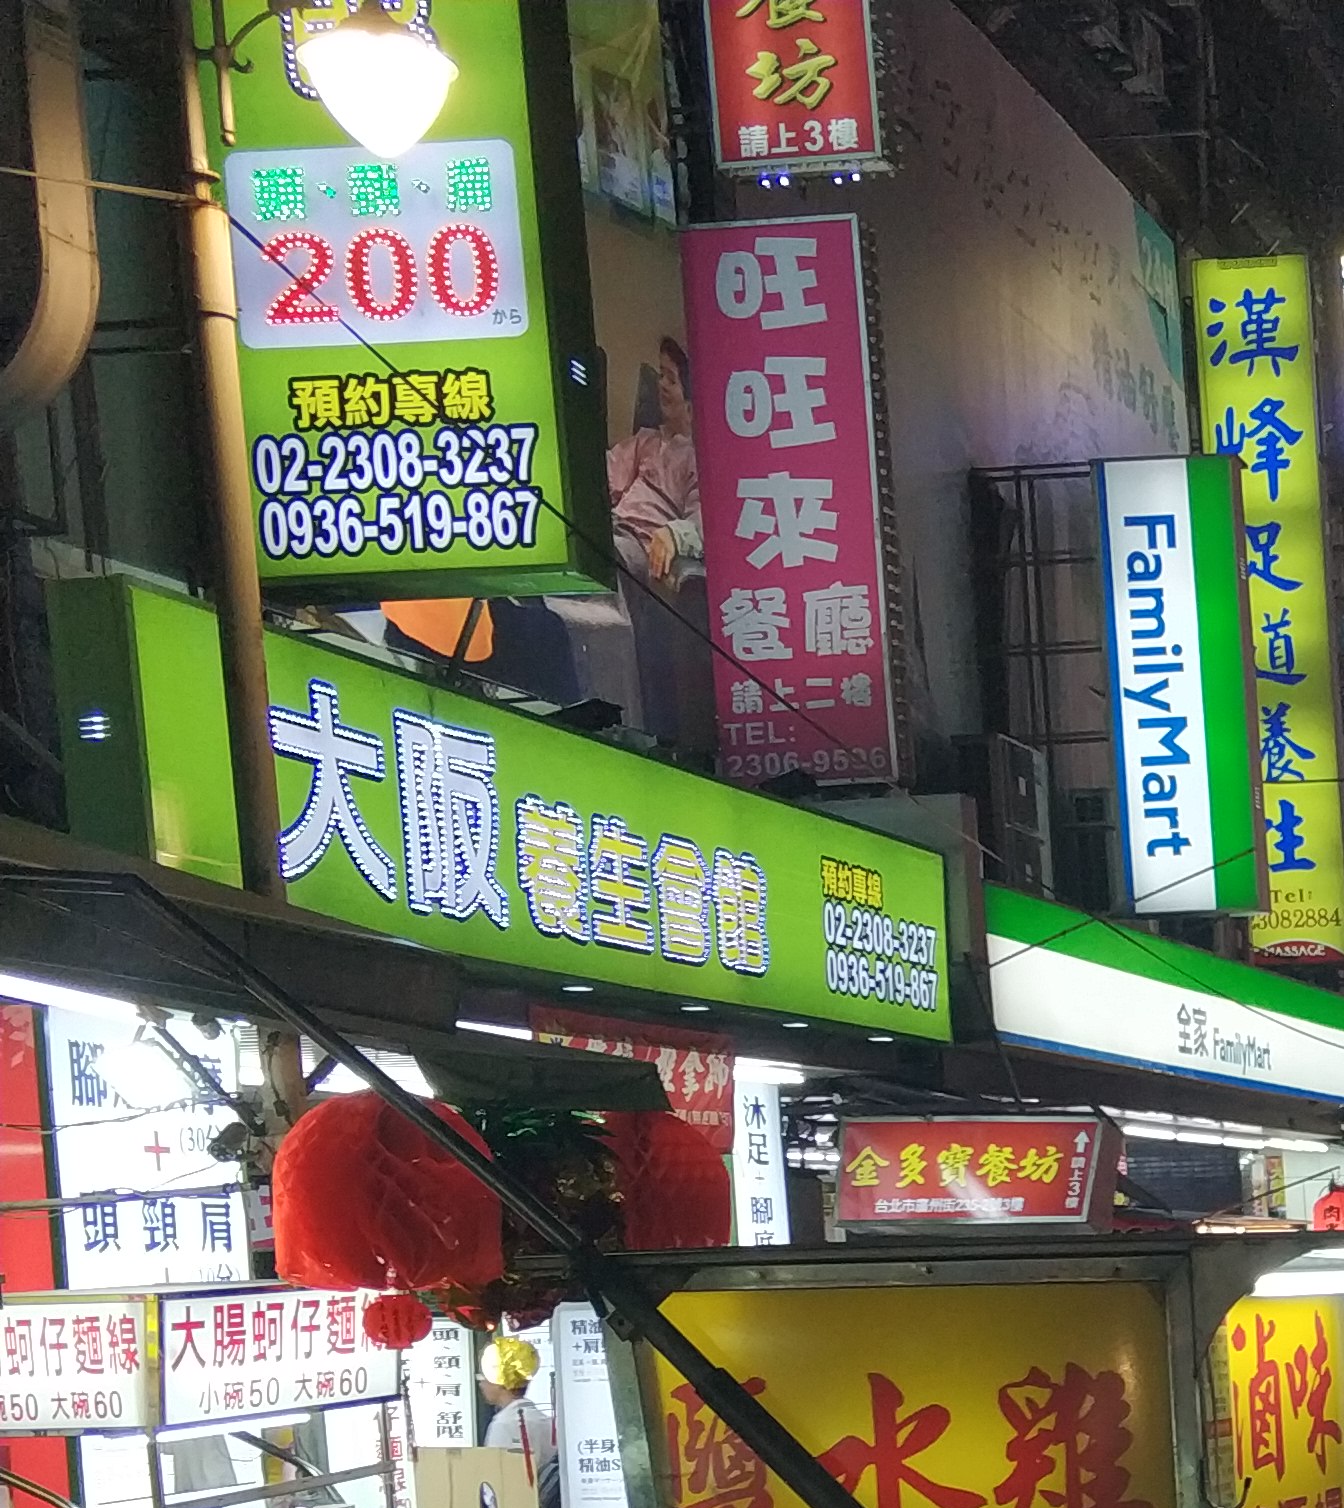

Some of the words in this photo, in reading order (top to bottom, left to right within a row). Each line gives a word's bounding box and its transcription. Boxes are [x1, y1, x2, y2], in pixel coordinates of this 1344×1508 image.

[739, 118, 858, 158] 請上3樓
[261, 222, 500, 326] 200
[290, 370, 493, 431] 預約專線
[715, 236, 840, 569] 旺旺來
[253, 425, 536, 493] 02-2308-3237
[262, 490, 541, 559] 0936-519-867
[719, 581, 874, 661] 餐廳
[730, 672, 874, 716] 請上二樓
[1122, 513, 1193, 857] FamilyMart
[723, 721, 796, 746] TEL:
[267, 679, 511, 929] 大阪
[821, 856, 883, 910] 預約專線
[823, 901, 936, 965] 02-2308-3237
[826, 946, 939, 1012] 0936-519-867
[1177, 1003, 1209, 1056] 全家
[1213, 1027, 1272, 1075] FamilyMart
[845, 1143, 1065, 1188] 金多寶餐坊
[51, 1391, 122, 1420] 大碗60
[577, 1439, 619, 1454] (半身
[578, 1457, 622, 1473] 精油S
